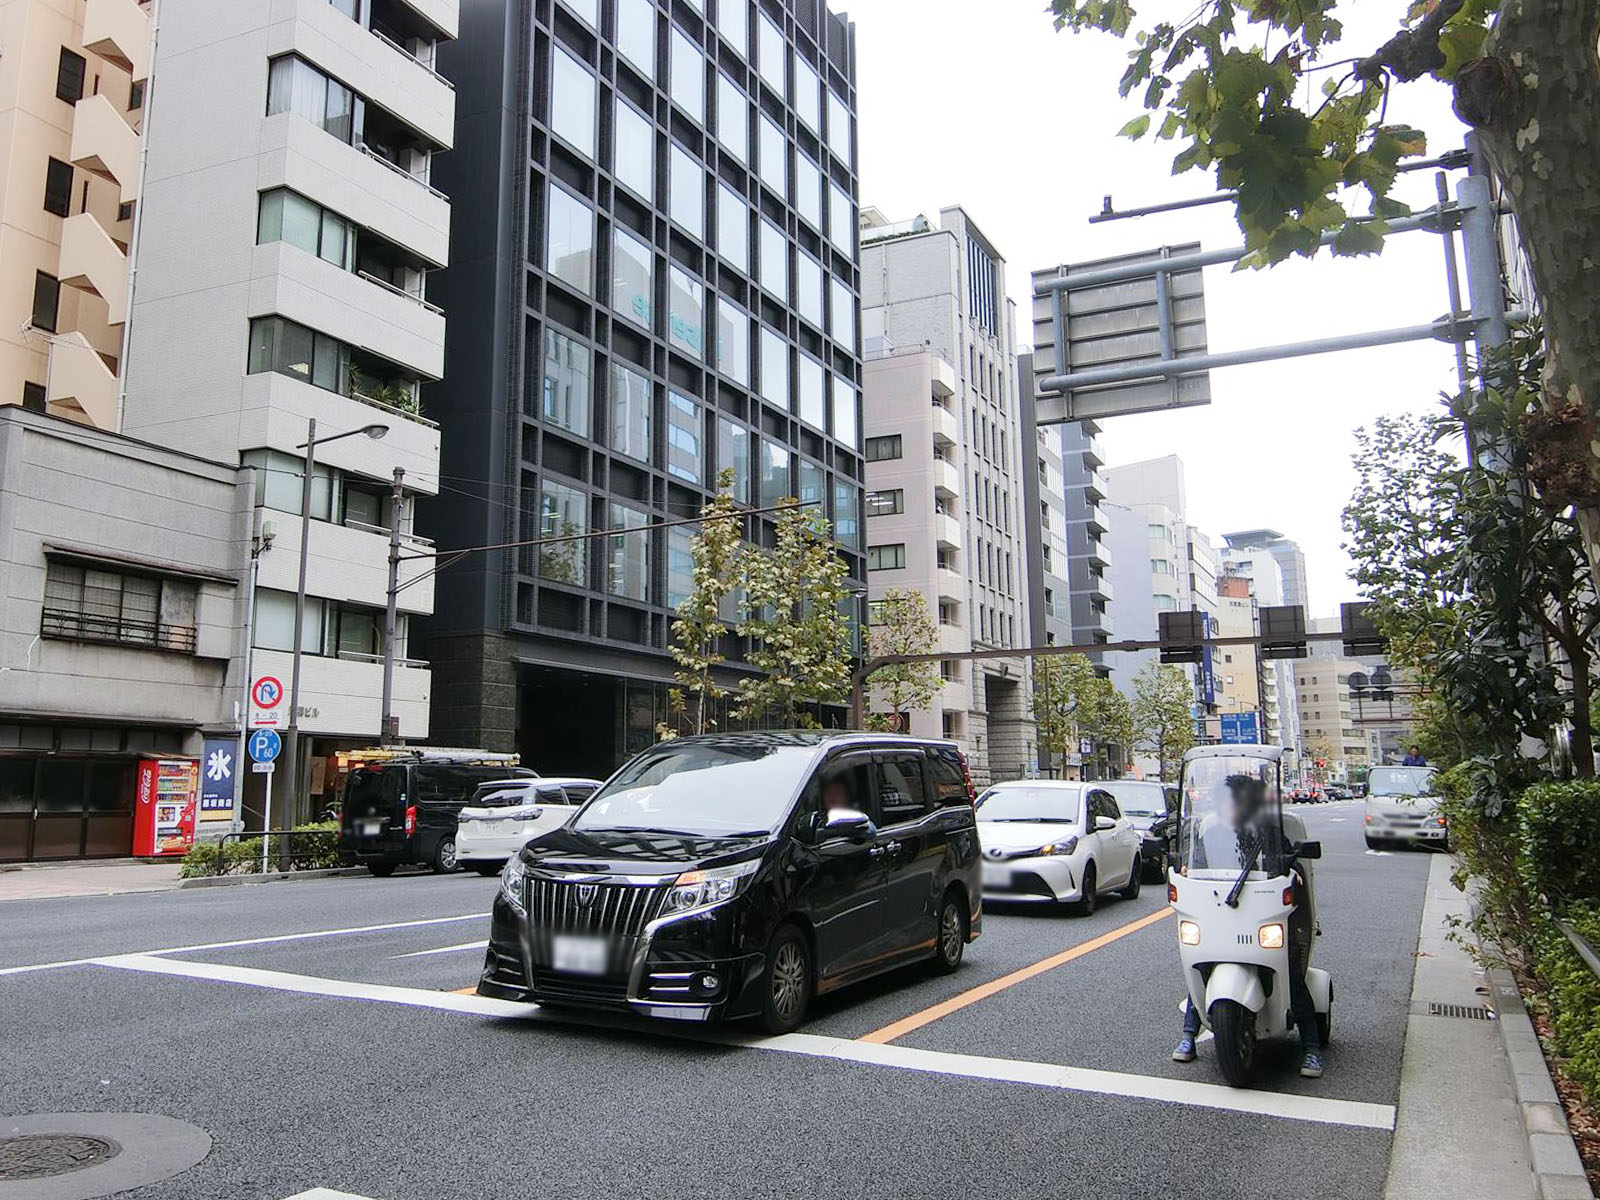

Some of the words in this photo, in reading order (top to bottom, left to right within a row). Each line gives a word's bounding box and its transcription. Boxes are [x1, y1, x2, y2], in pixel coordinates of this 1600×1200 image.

[255, 737, 269, 759] P
[263, 748, 274, 758] 60
[207, 749, 232, 781] 氷
